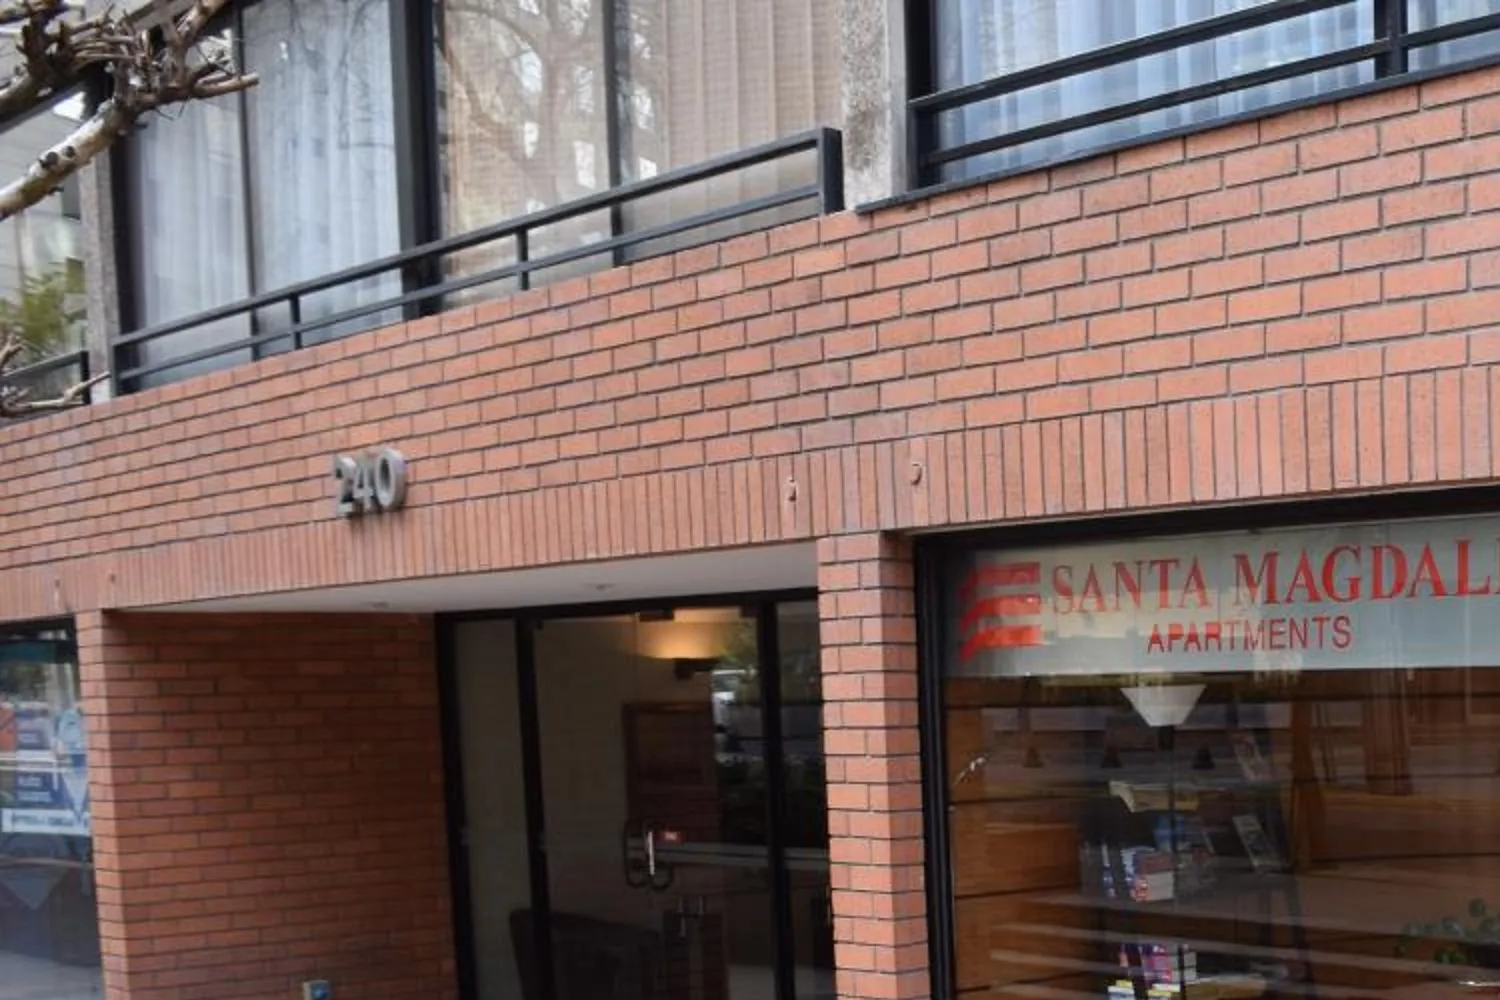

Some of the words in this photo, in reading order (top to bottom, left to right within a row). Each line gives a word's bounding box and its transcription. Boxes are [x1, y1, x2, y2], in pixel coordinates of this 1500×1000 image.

[334, 447, 408, 516] 240
[1052, 556, 1213, 615] SANTA
[1147, 615, 1352, 653] APARTMENTS
